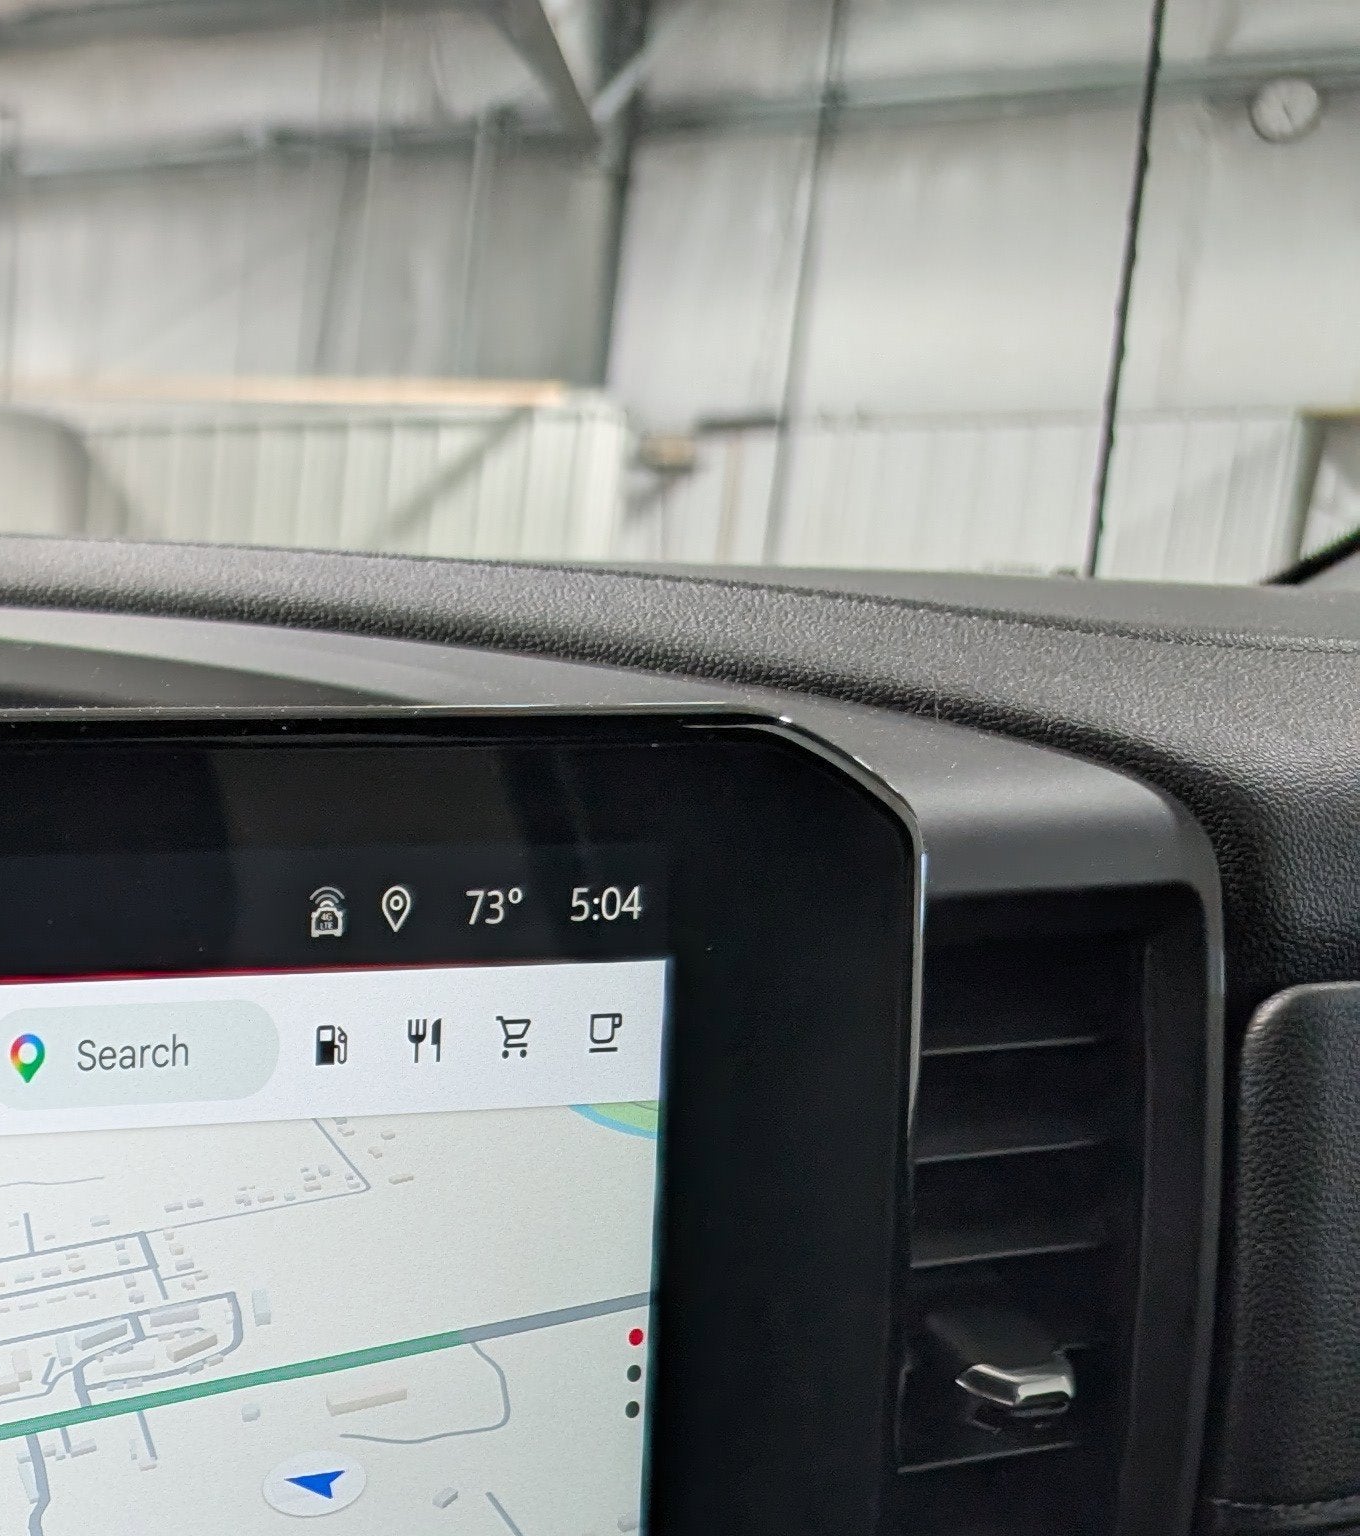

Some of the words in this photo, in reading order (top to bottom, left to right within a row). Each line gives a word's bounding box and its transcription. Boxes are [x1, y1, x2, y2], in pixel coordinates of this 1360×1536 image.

[465, 887, 523, 925] 73°
[570, 885, 643, 922] 5:04
[77, 1032, 190, 1072] Search
